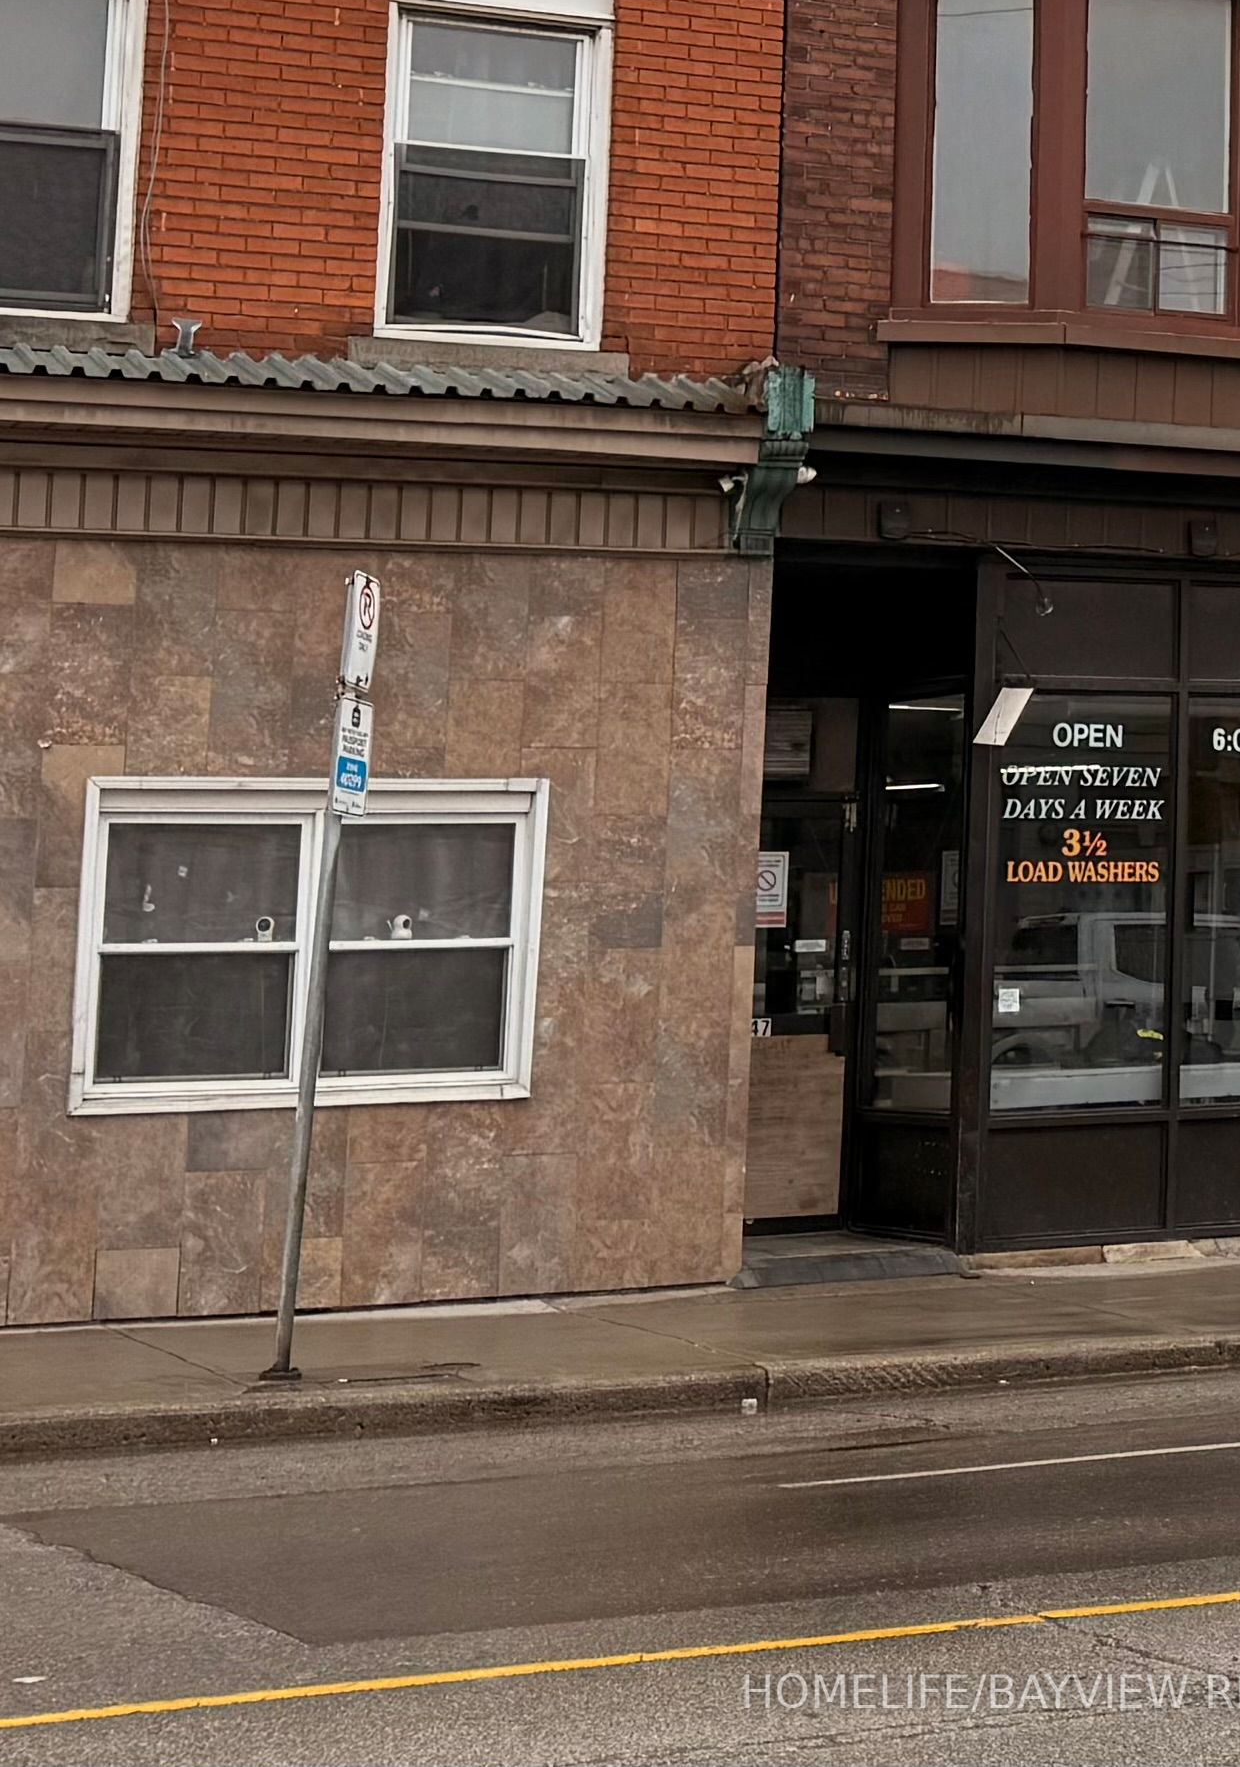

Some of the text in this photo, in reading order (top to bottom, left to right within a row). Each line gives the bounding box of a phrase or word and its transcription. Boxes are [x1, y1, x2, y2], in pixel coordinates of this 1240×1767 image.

[1053, 723, 1123, 748] OPEN
[1002, 765, 1162, 787] OPEN SEVEN
[1003, 798, 1166, 821] DAYS A WEEK
[1007, 861, 1160, 883] LOAD WASHERS
